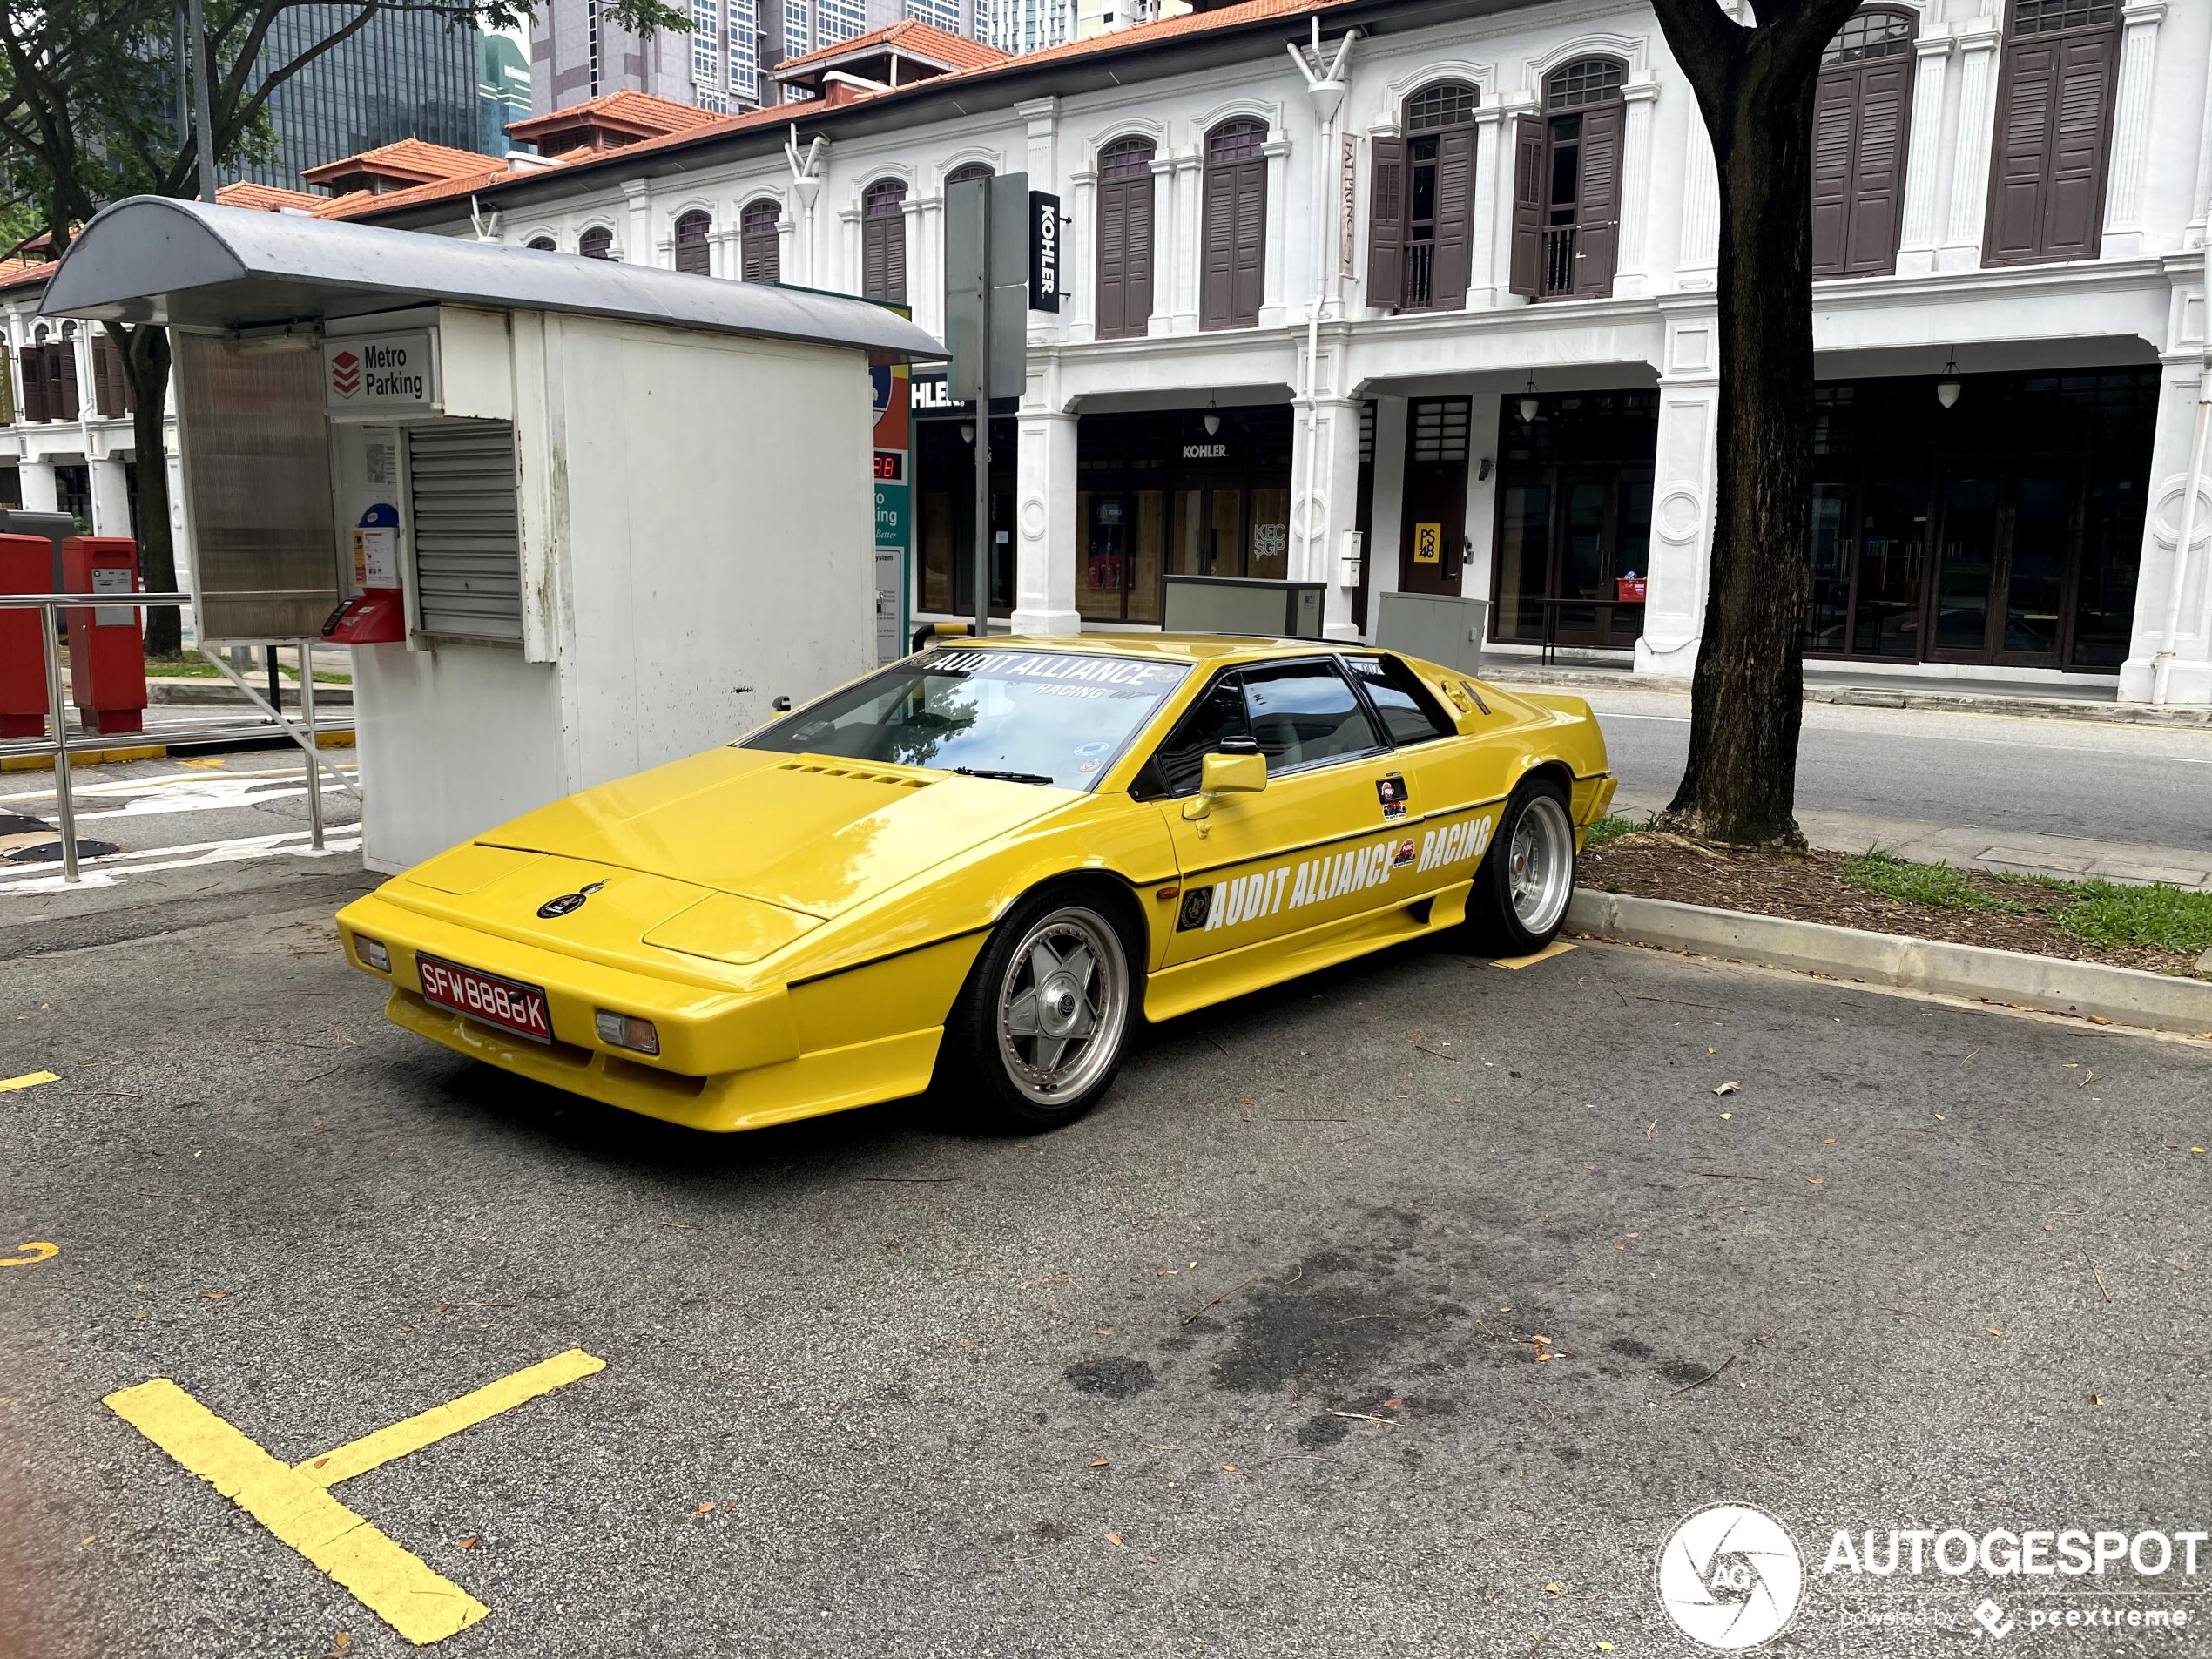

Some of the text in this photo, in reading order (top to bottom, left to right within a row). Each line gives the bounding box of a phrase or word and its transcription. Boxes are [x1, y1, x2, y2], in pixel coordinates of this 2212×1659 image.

[1345, 142, 1354, 172] FAT
[1042, 204, 1055, 293] KOHLER
[365, 346, 407, 368] Metro
[366, 371, 423, 399] Parking
[1183, 445, 1227, 458] KOHLER
[876, 529, 897, 539] Better
[1254, 524, 1286, 540] KEC
[1420, 529, 1435, 550] PS
[1254, 540, 1286, 556] SGP
[1419, 544, 1435, 557] 48
[923, 652, 1022, 673] AUDIT
[1005, 656, 1165, 685] ALLIANCE
[1032, 683, 1107, 698] RACING
[1204, 866, 1291, 932] AUDIT
[1288, 840, 1398, 910] ALLIANCE
[1416, 815, 1492, 873] RACING
[422, 963, 547, 1030] SFW8888K
